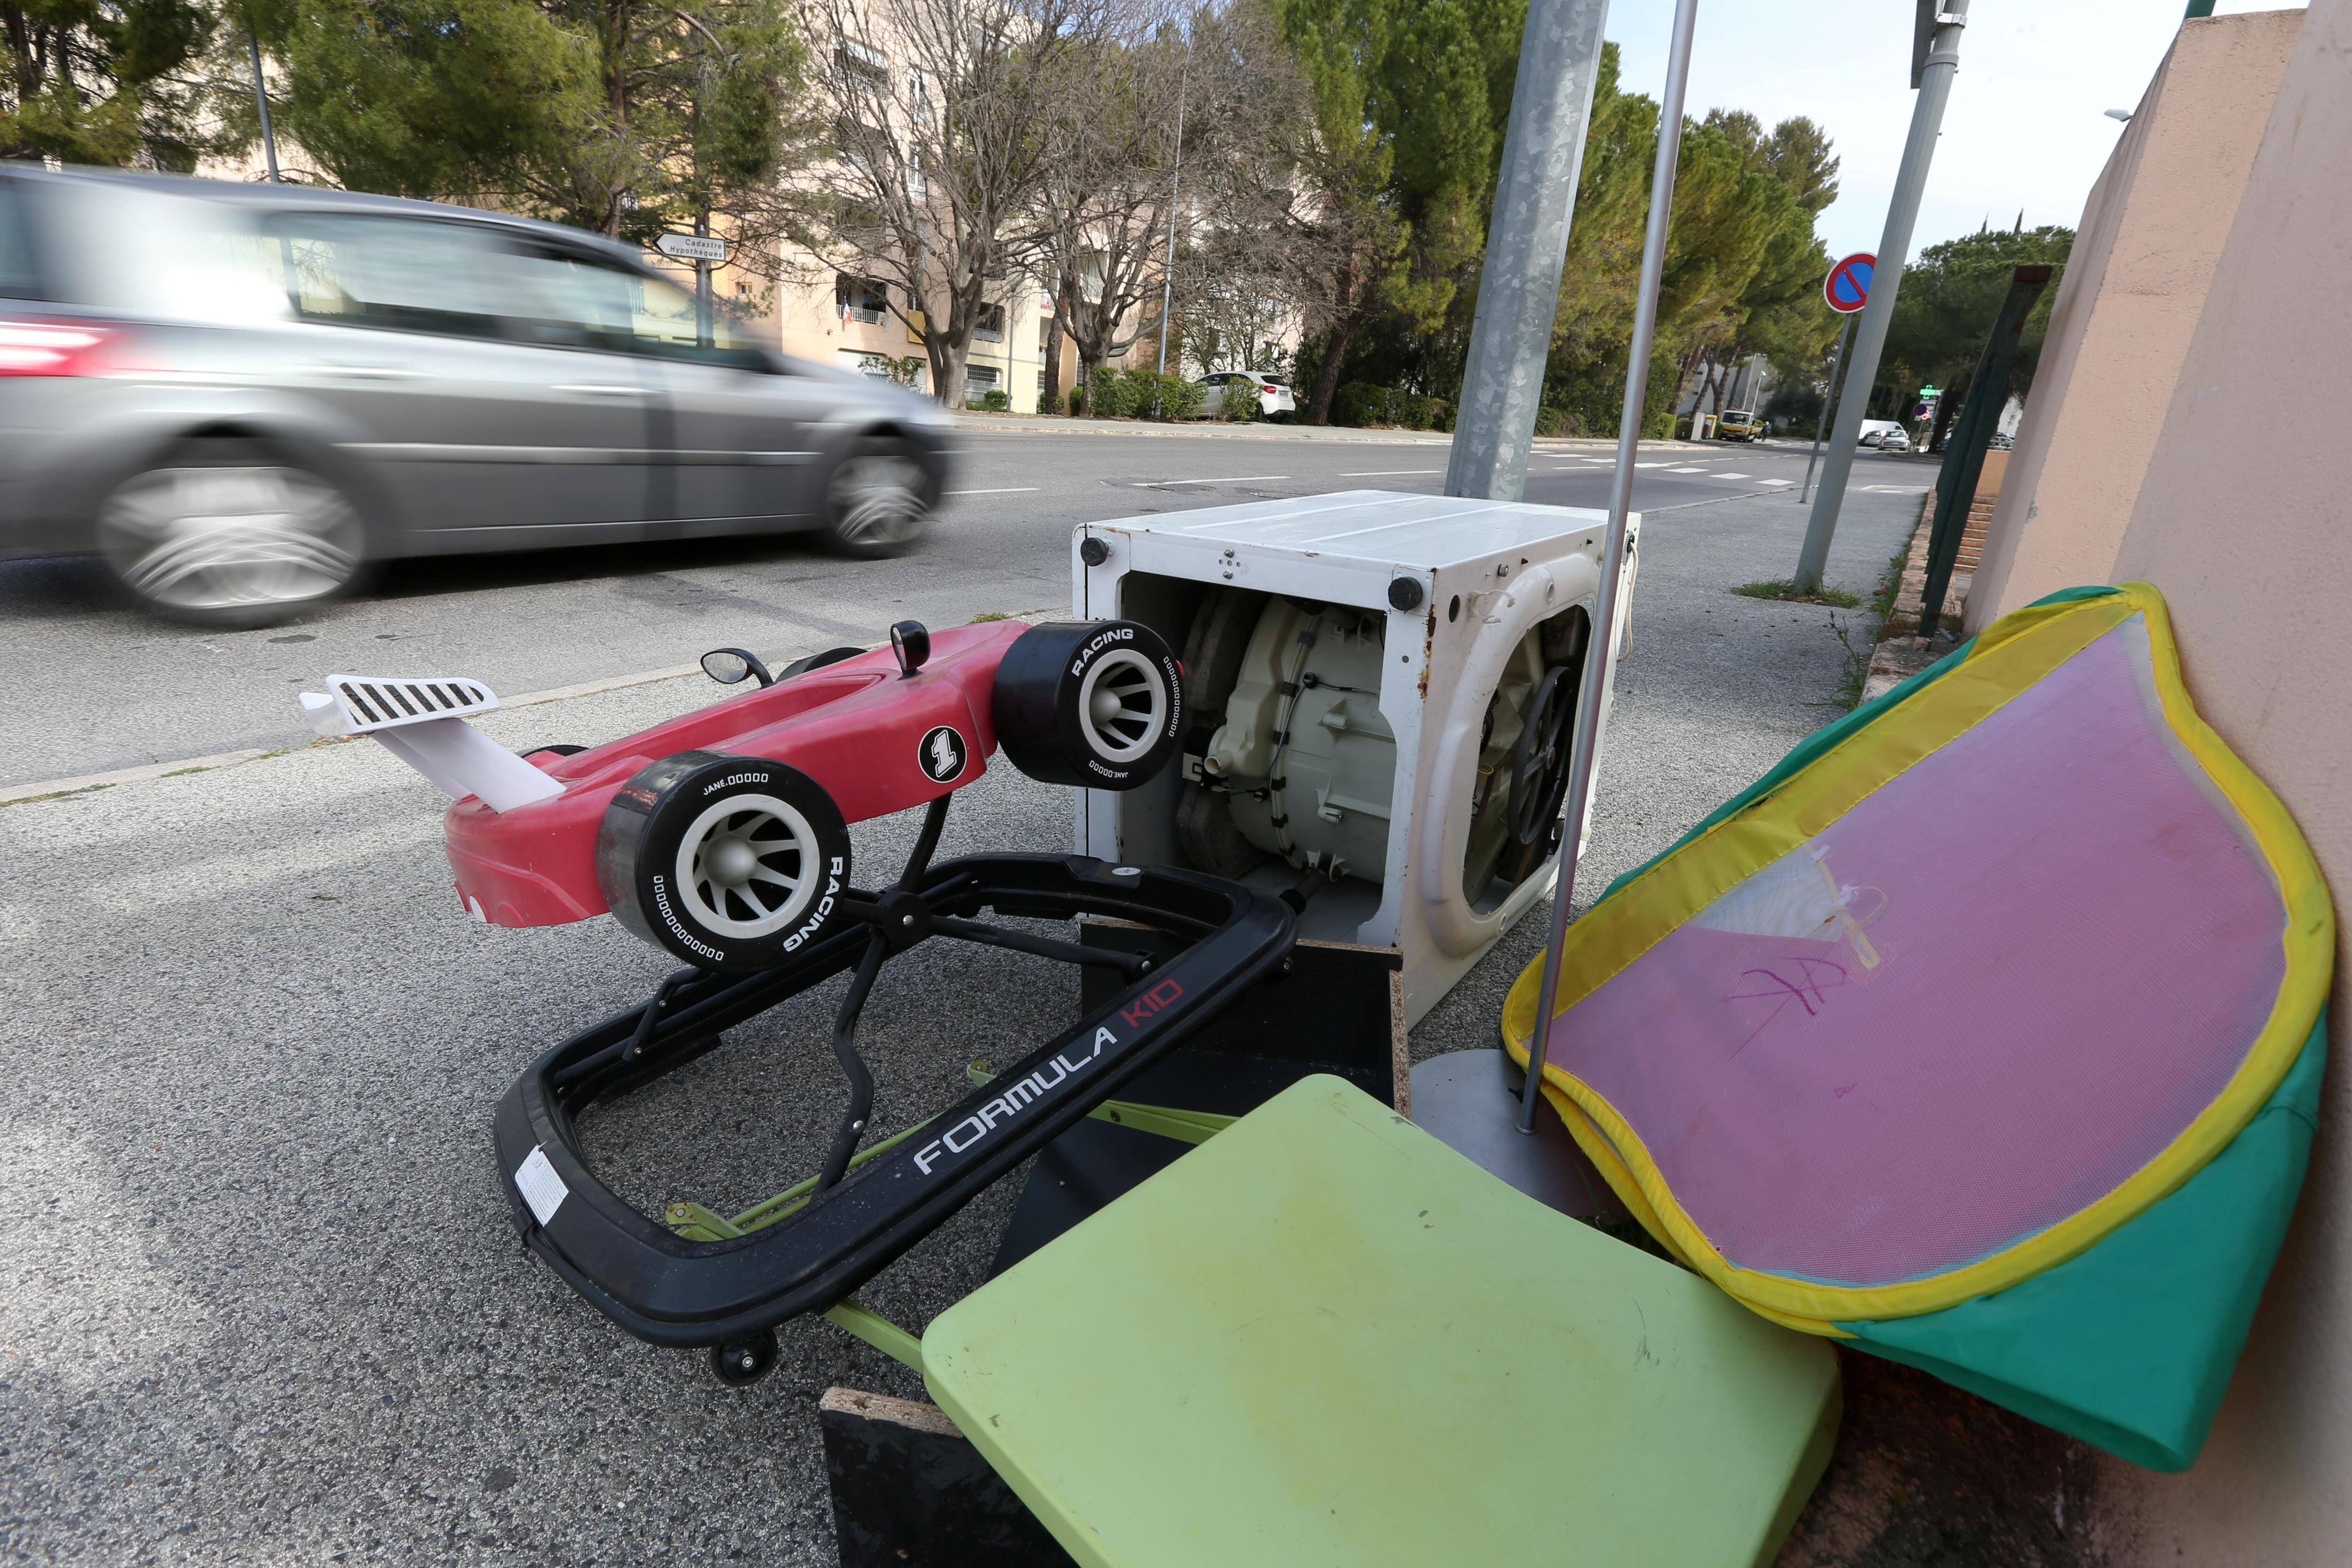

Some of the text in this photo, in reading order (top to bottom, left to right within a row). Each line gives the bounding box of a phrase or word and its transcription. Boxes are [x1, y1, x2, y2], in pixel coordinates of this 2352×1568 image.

[670, 246, 722, 257] Hypothèques
[685, 239, 722, 249] Cadastre
[1072, 629, 1133, 677] RACING
[931, 729, 957, 778] 1
[783, 857, 843, 952] RACING
[913, 978, 1184, 1175] FORMULA KID
